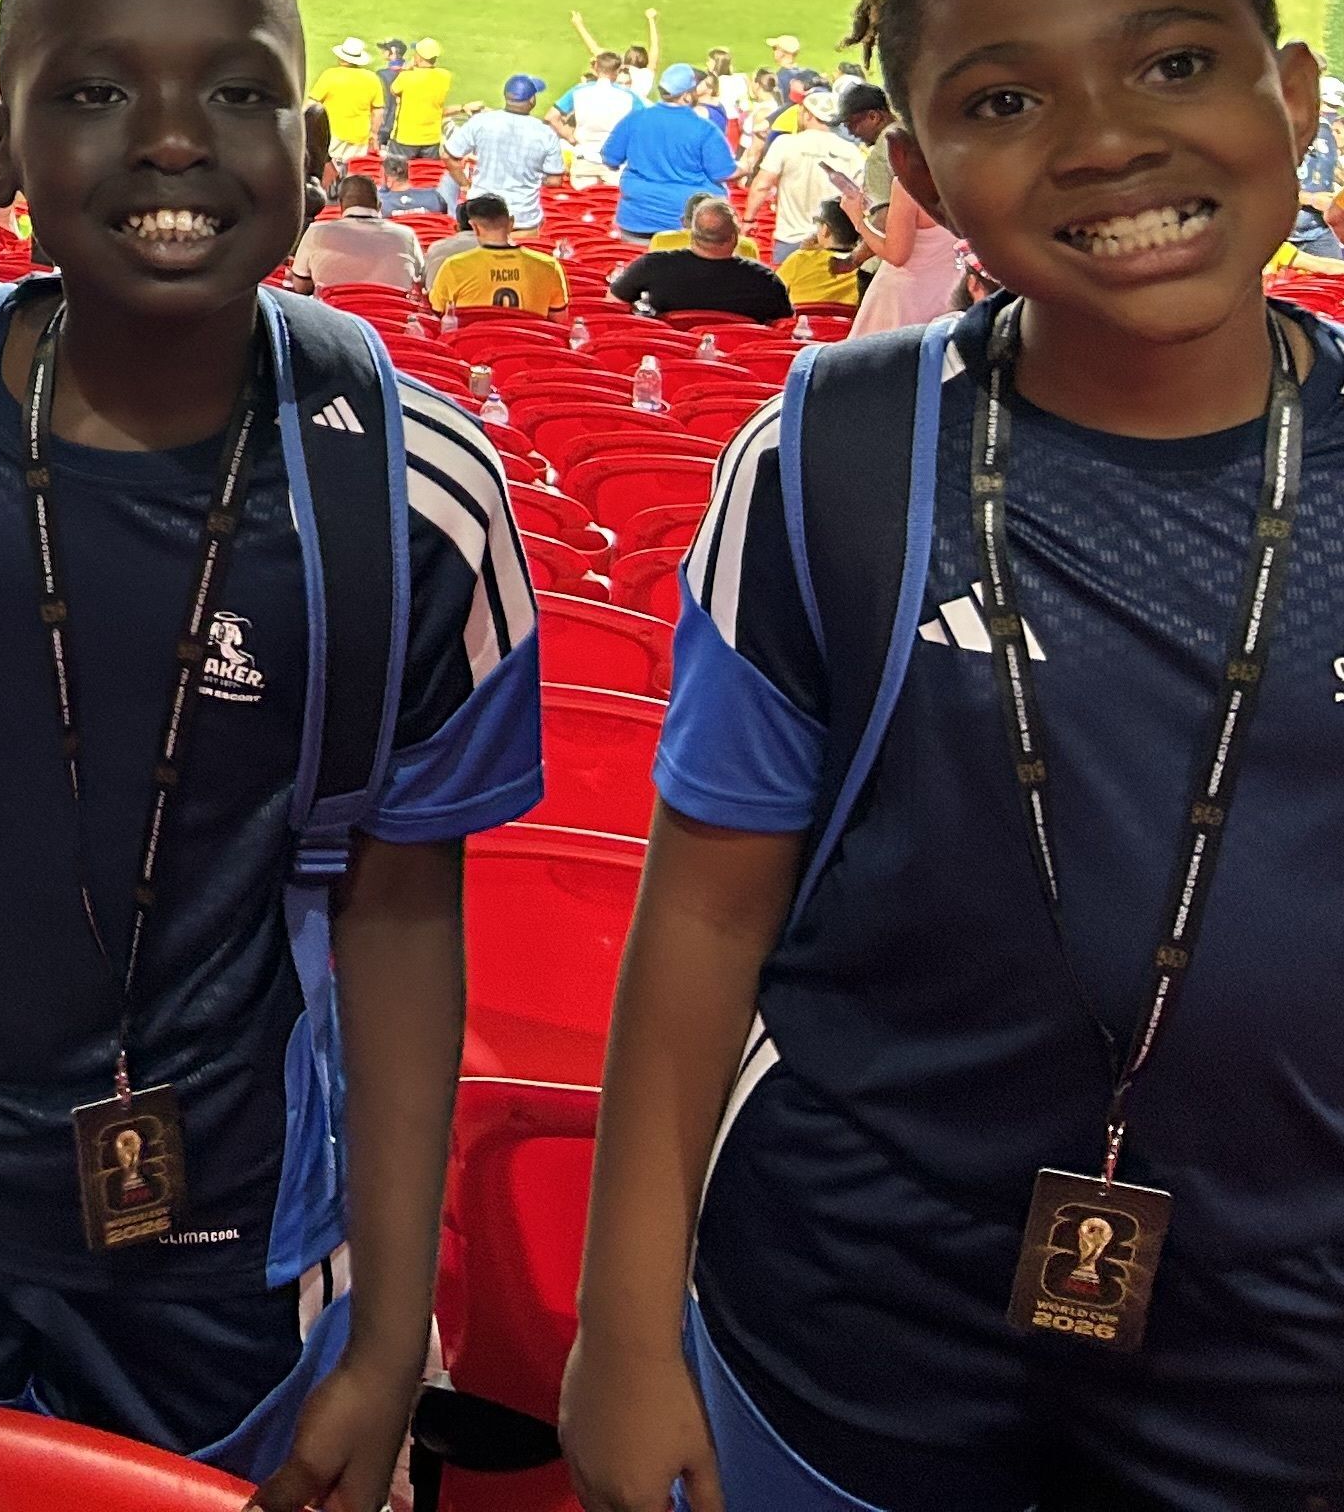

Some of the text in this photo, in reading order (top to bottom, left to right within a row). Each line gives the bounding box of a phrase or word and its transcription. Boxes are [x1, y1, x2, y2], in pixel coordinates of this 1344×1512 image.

[490, 268, 520, 282] PACHO
[203, 657, 263, 687] AKER
[1036, 1298, 1089, 1319] WORLD
[1031, 1309, 1117, 1340] 2026
